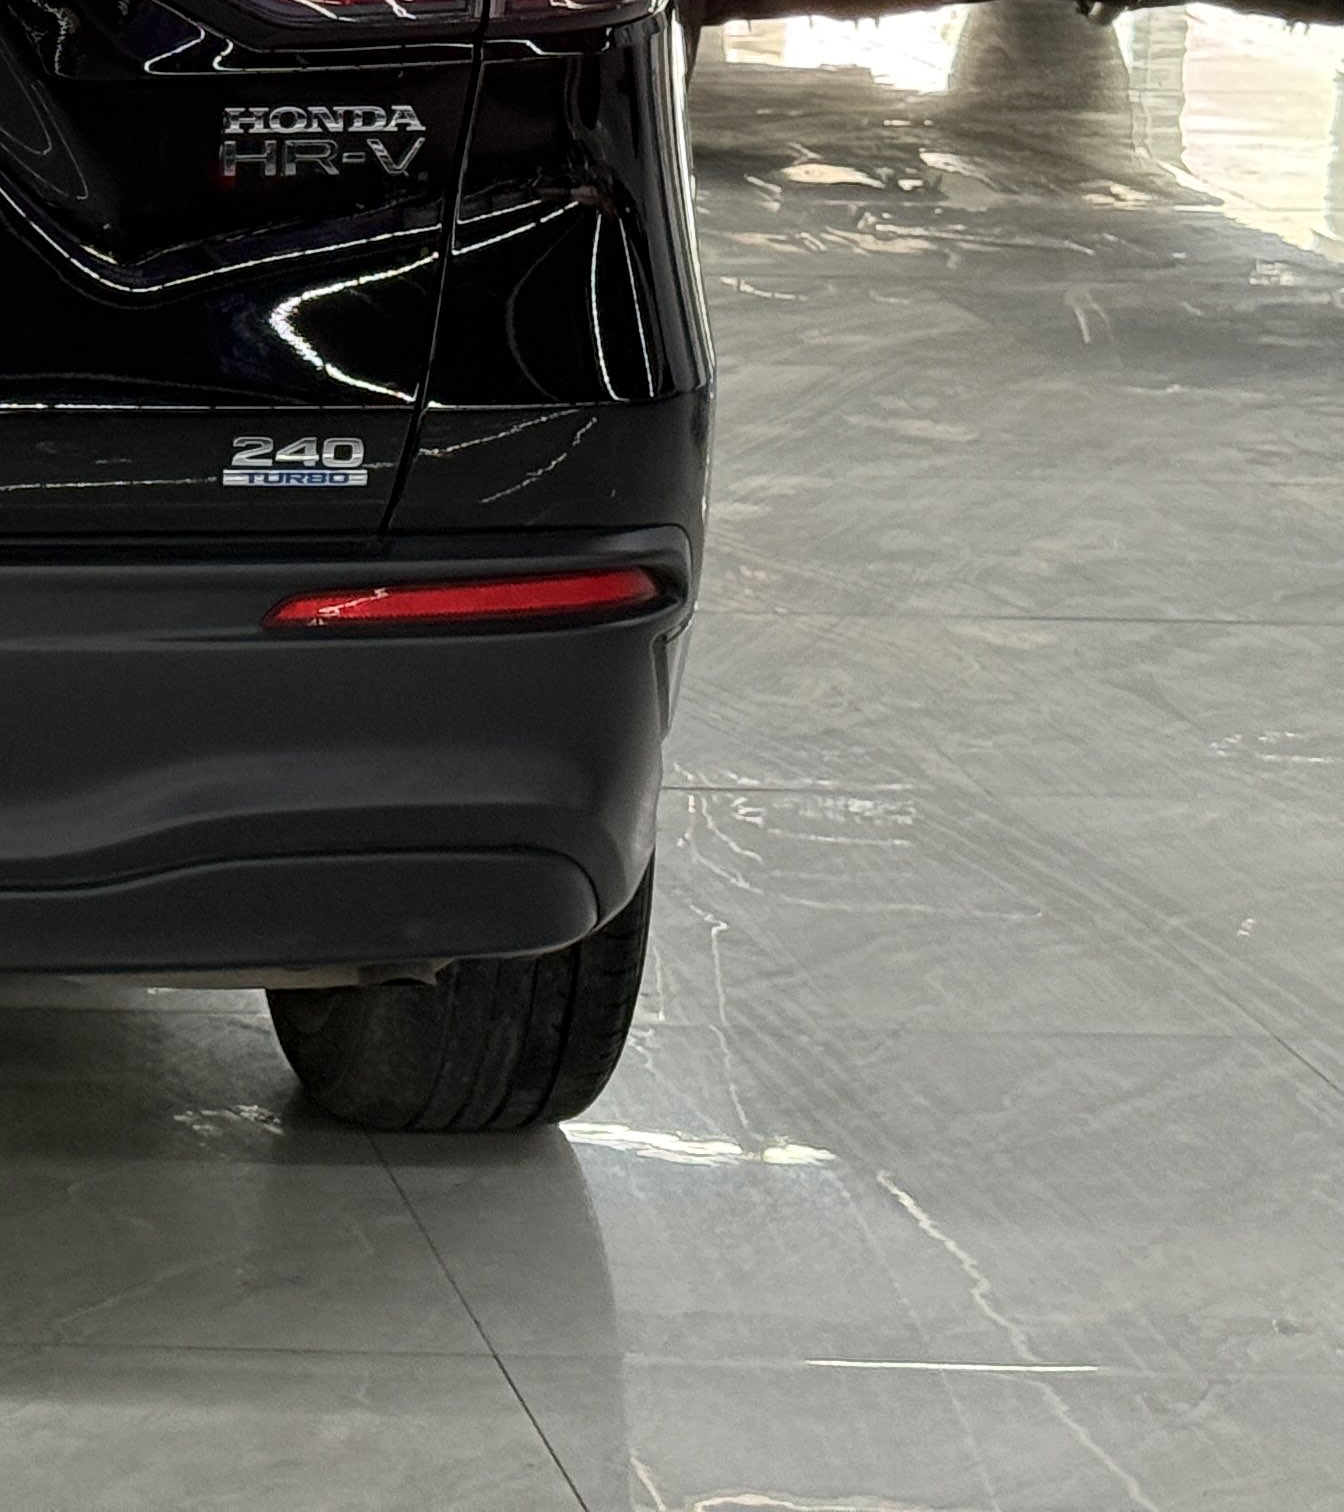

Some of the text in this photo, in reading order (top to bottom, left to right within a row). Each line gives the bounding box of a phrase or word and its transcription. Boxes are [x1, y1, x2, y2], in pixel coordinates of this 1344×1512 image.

[222, 105, 427, 134] HONDA
[222, 138, 426, 177] HR-V
[231, 436, 365, 468] 240
[245, 472, 351, 485] TURBO
